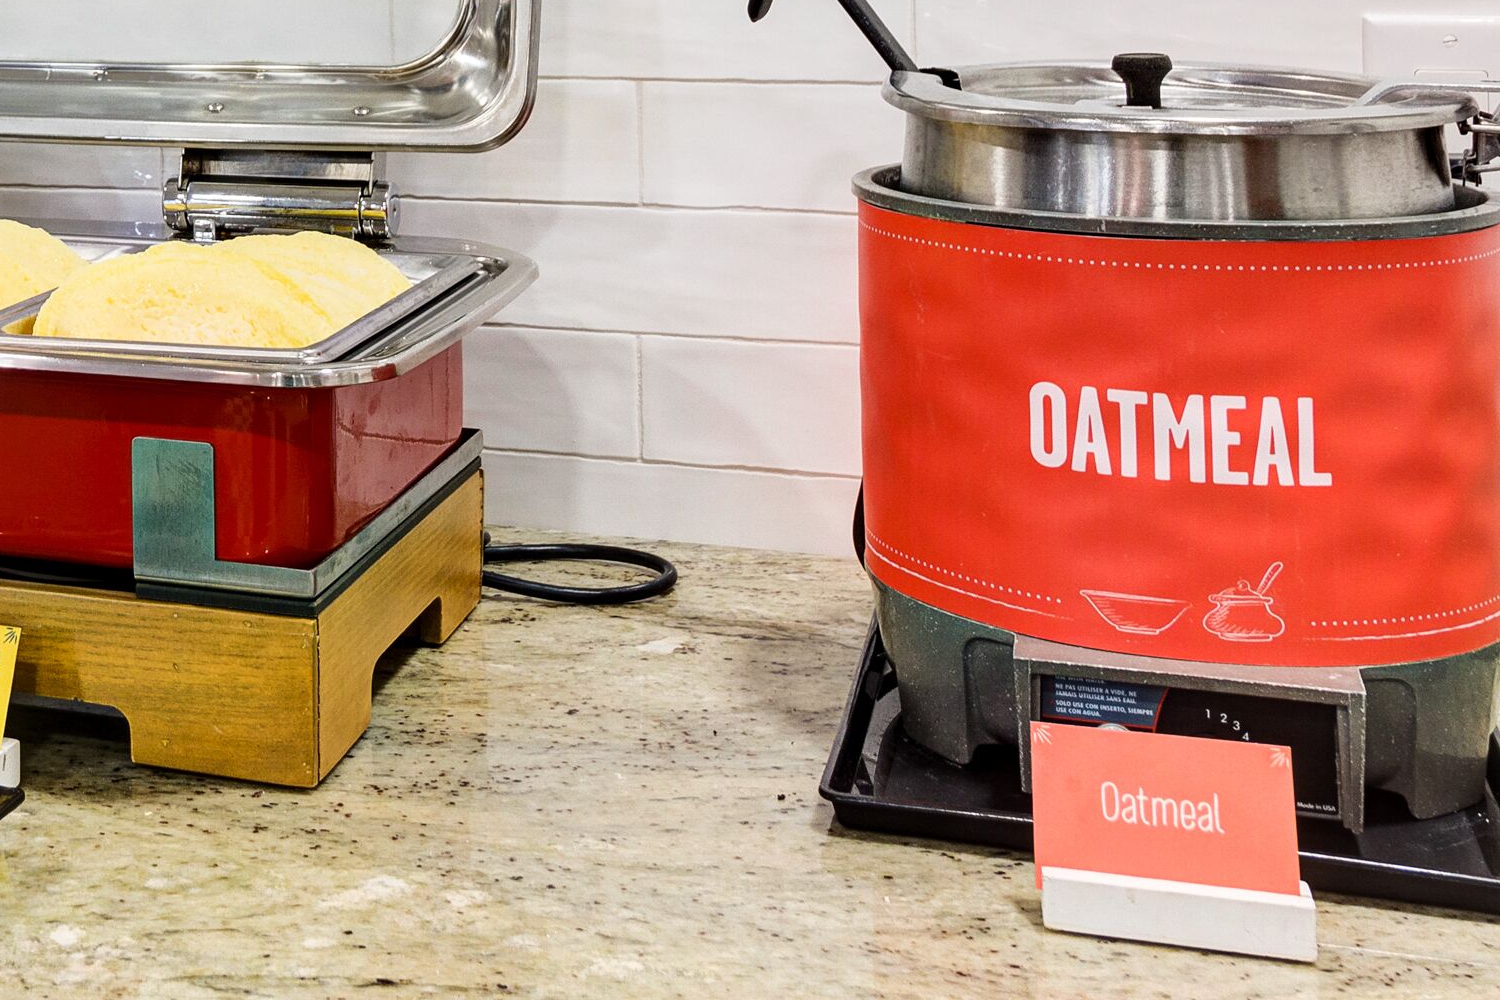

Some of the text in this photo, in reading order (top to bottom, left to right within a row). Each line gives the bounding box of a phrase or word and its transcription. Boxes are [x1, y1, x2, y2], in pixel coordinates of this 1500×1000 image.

[1029, 381, 1332, 486] OATMEAL
[1055, 690, 1077, 698] JAMAIS
[1078, 692, 1105, 701] UTILISER
[1077, 685, 1104, 693] UTILISER
[1085, 702, 1099, 710] CON
[1127, 707, 1153, 716] SIEMPRE
[1205, 708, 1250, 741] 1 2 3 4
[1100, 780, 1225, 834] Oatmeal
